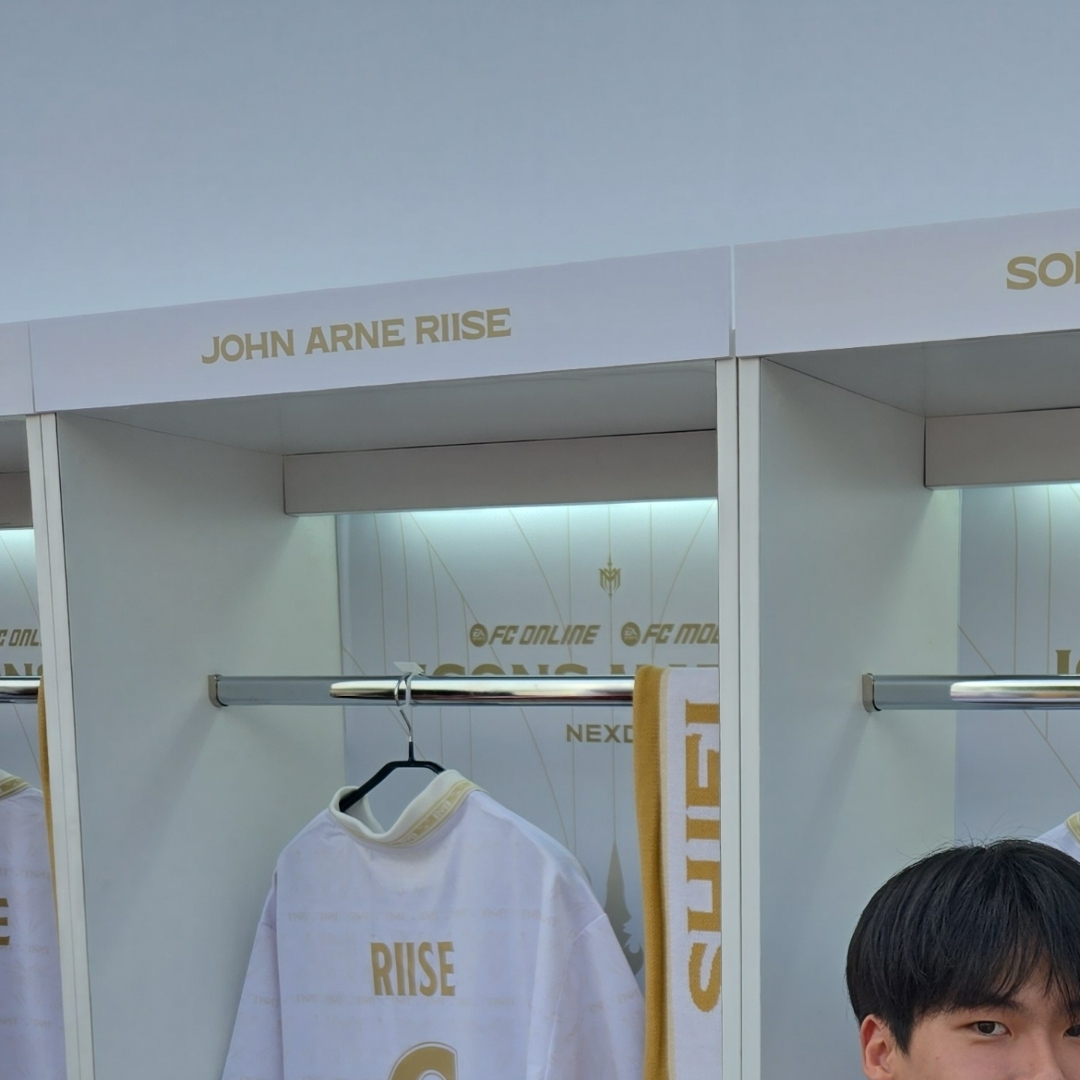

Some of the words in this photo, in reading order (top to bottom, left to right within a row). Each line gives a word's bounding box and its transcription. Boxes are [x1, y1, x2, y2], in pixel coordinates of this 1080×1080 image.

[201, 329, 296, 364] JOHN
[304, 318, 406, 355] ARNE
[415, 308, 512, 345] RIISE
[8, 629, 42, 647] ONL
[488, 625, 519, 645] FC
[518, 624, 601, 645] ONLINE
[641, 624, 675, 645] FC
[673, 623, 719, 645] MOB
[370, 941, 456, 998] RIISE
